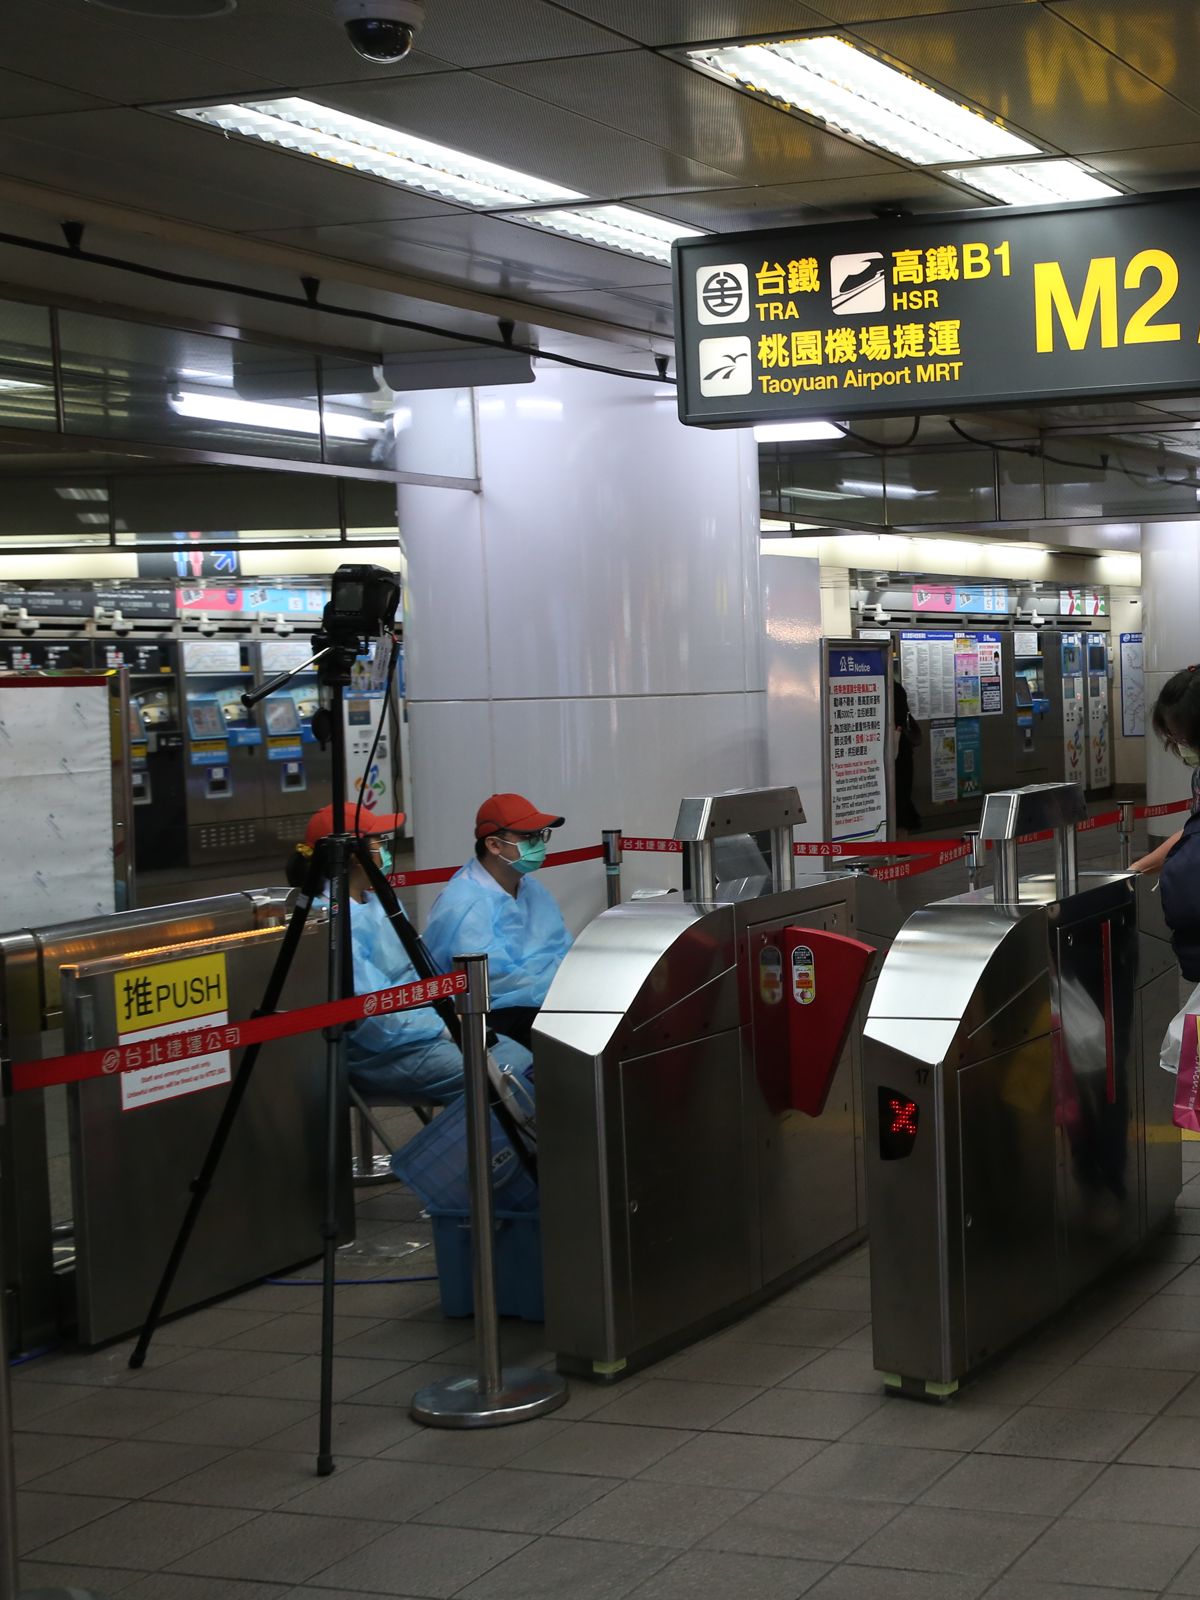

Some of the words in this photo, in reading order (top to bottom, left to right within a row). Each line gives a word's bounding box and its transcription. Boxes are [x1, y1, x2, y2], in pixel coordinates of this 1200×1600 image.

[754, 256, 821, 298] 台鐵
[754, 301, 800, 322] TRA
[892, 290, 939, 312] HSR
[1033, 248, 1182, 354] M2
[757, 320, 962, 369] 桃園機場捷運
[758, 373, 838, 397] Taoyuan
[842, 366, 912, 391] Airport
[915, 362, 964, 384] MRT
[840, 656, 854, 672] 公告
[854, 663, 871, 672] Notice
[623, 839, 683, 852] 台北捷運公
[123, 977, 154, 1020] 推
[156, 974, 222, 1014] PUSH
[380, 972, 469, 1011] 台北捷運公司
[124, 1027, 241, 1068] 台北捷運公司
[915, 1068, 930, 1086] 17
